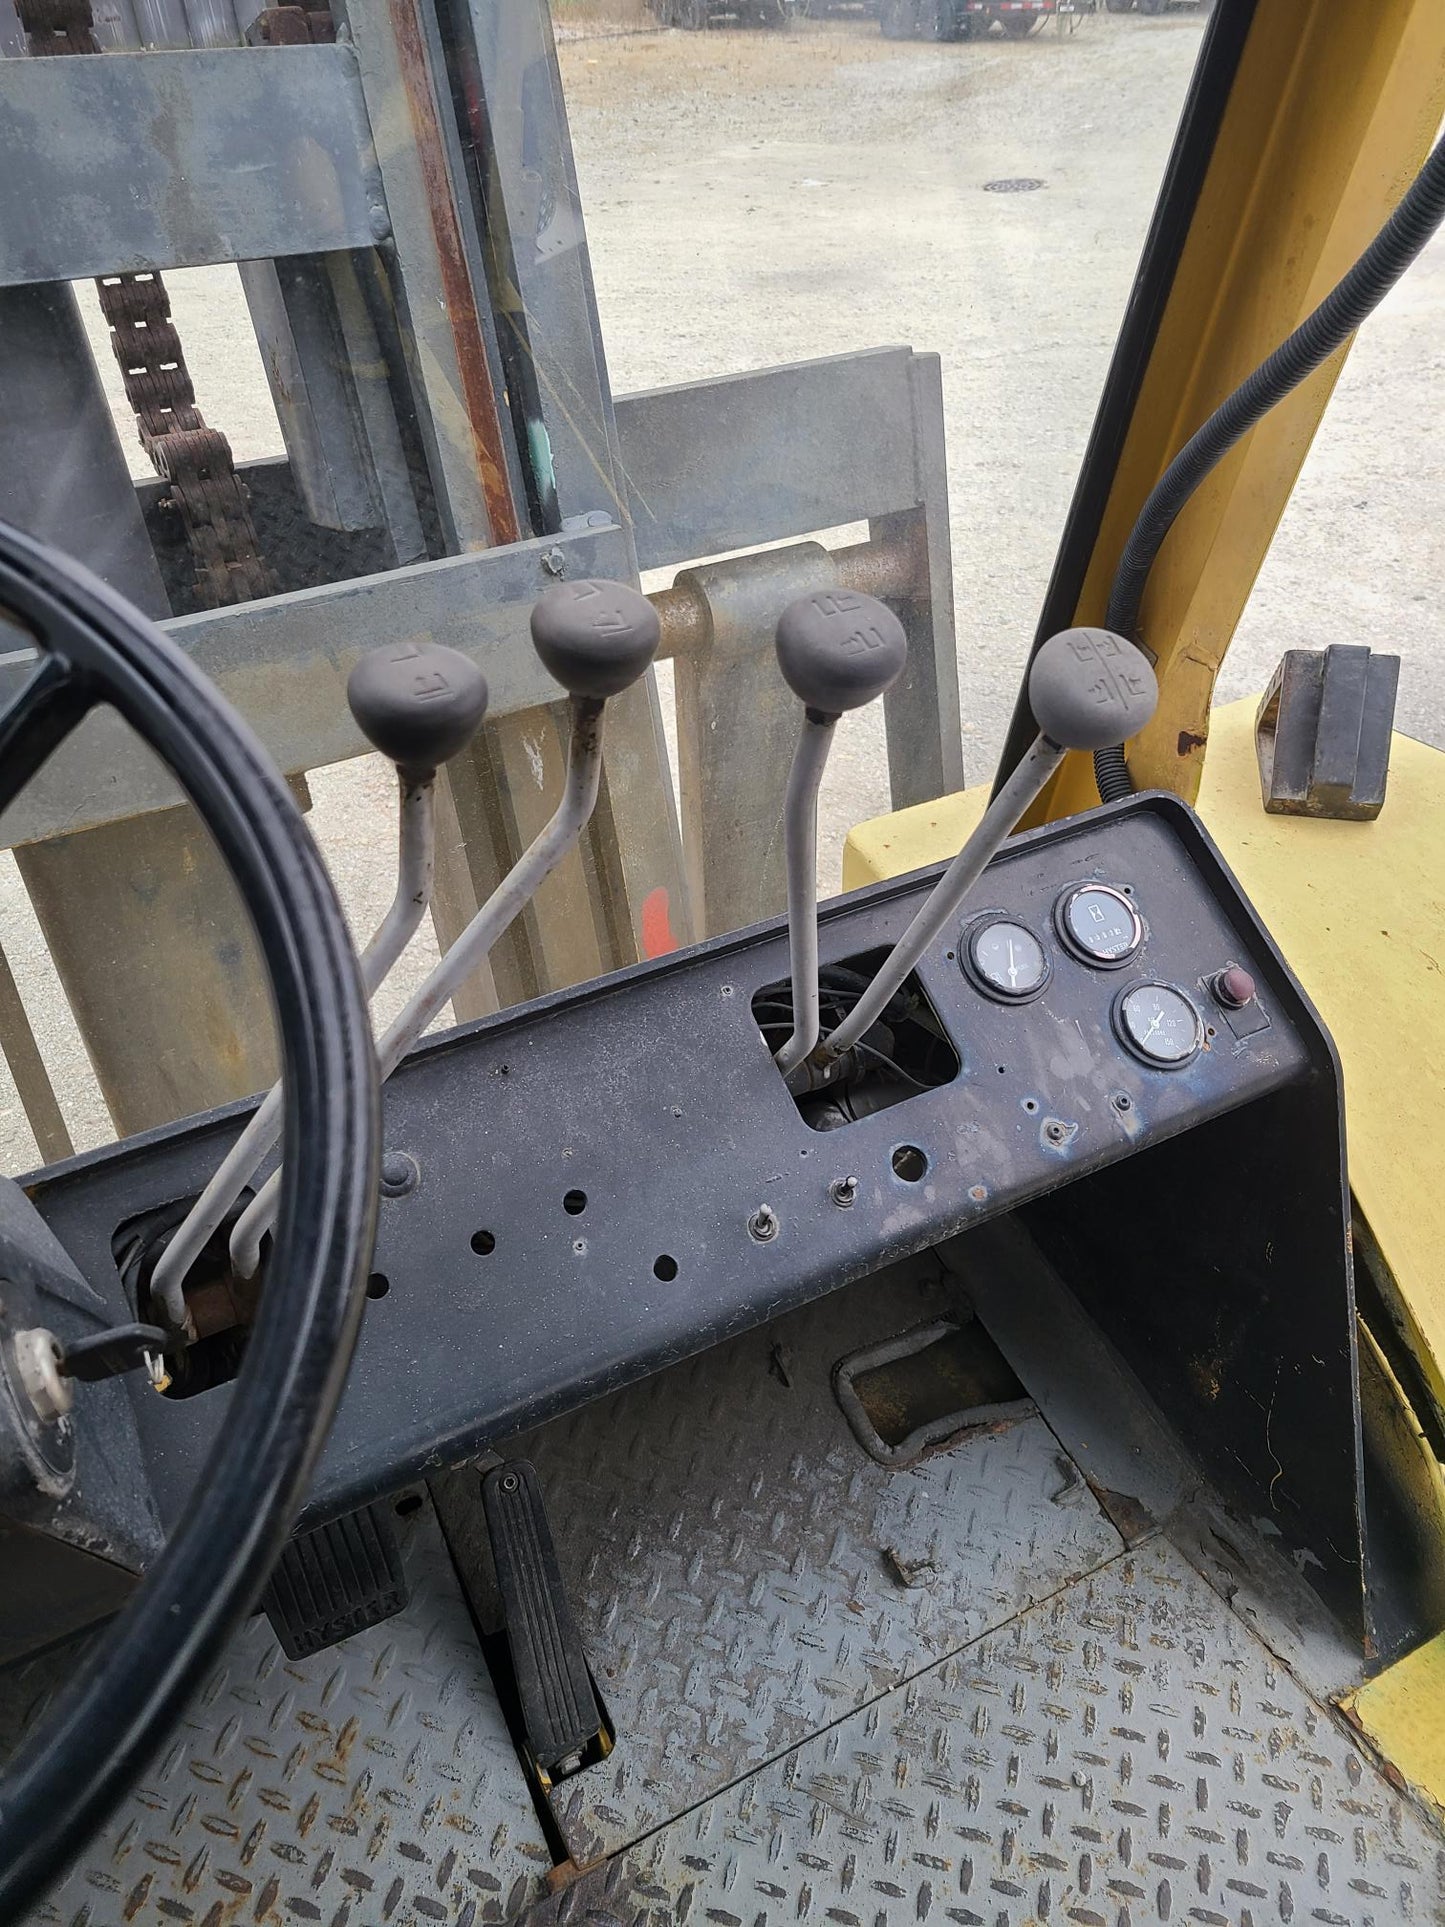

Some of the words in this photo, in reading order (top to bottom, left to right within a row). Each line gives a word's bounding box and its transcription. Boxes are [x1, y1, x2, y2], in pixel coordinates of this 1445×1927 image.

[1166, 1019, 1177, 1027] 120
[1164, 1037, 1175, 1046] 150
[291, 1590, 400, 1651] HYSTER
